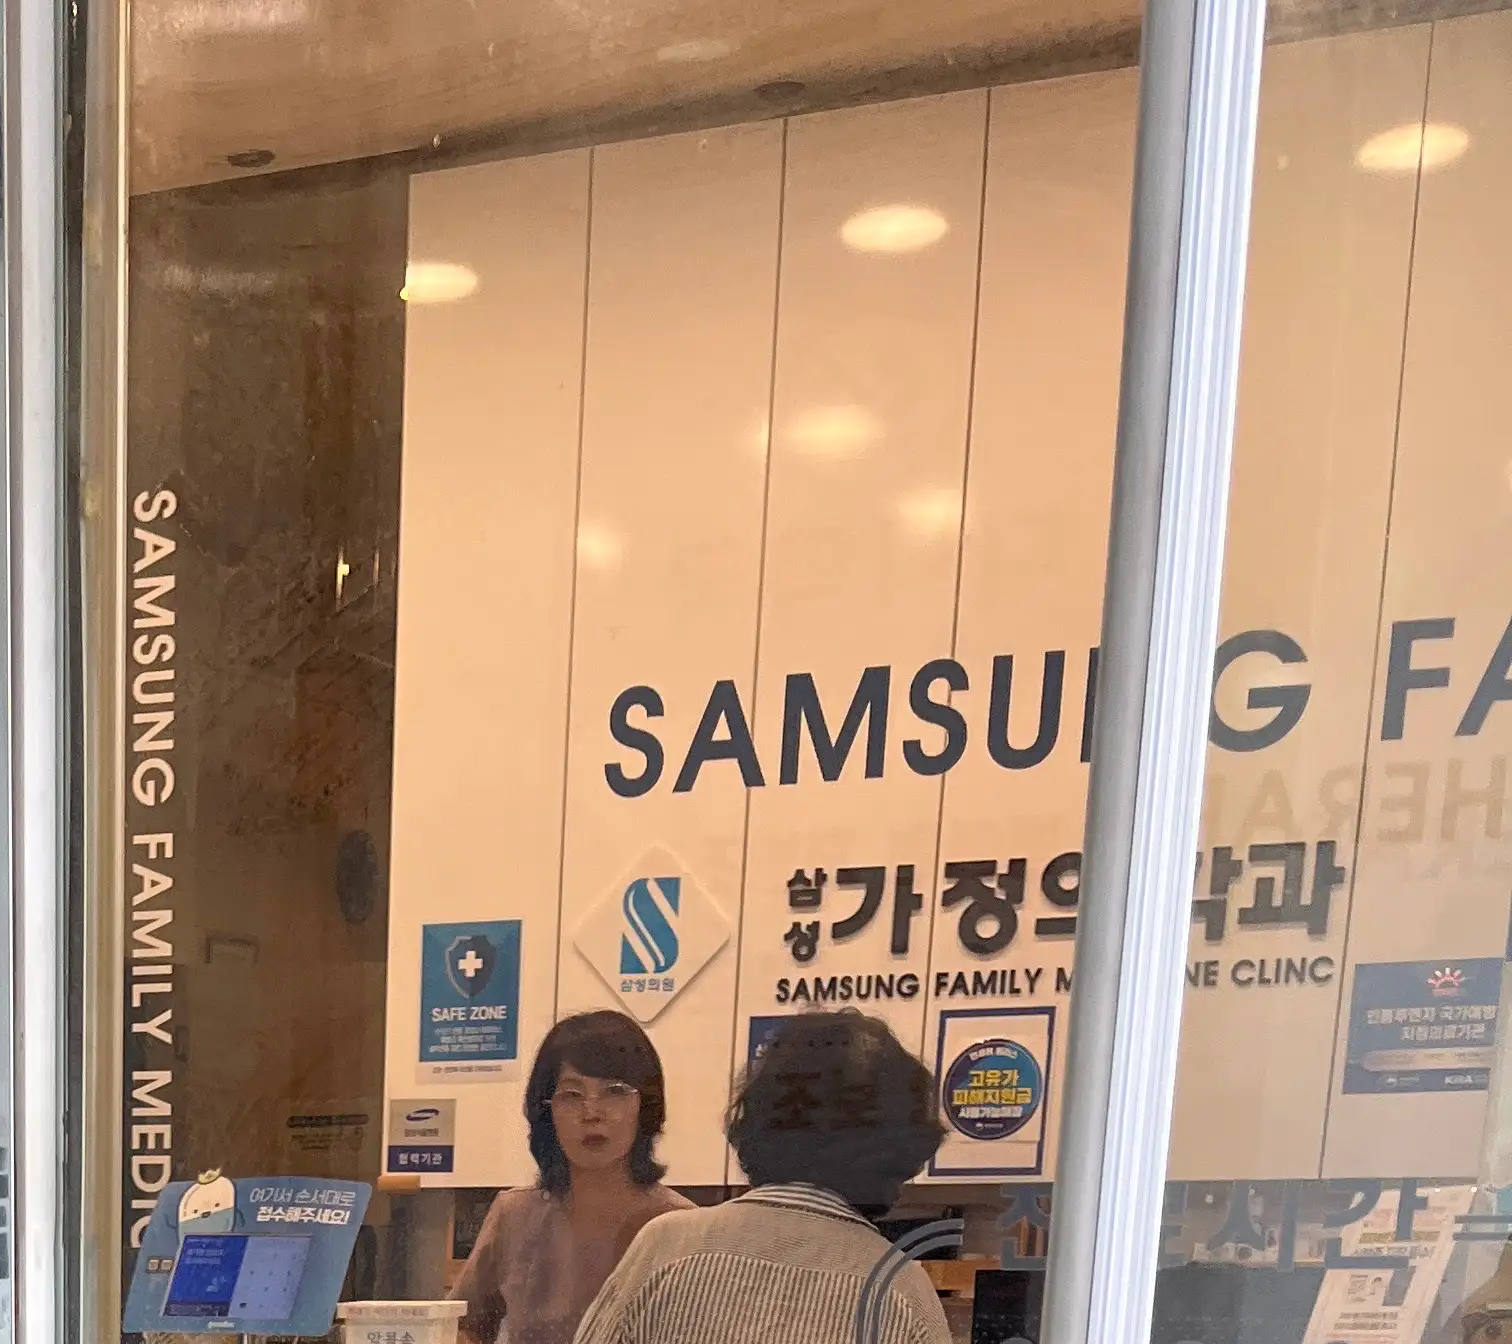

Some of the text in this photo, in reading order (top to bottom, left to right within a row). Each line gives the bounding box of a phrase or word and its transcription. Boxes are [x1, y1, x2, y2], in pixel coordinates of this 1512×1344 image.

[133, 488, 176, 807] SAMSUNG
[604, 629, 1312, 798] SAMSUG
[131, 831, 175, 1047] FAMILY
[1230, 956, 1336, 988] CLINC
[620, 977, 677, 993] 삼성의원
[776, 973, 920, 1003] SAMSUNG
[934, 968, 1044, 997] FAMILY
[432, 1004, 508, 1022] SAFE ZONE
[968, 1069, 1019, 1087] 고유가
[249, 1187, 294, 1204] 여기서
[257, 1206, 350, 1225] 접수해주세요!
